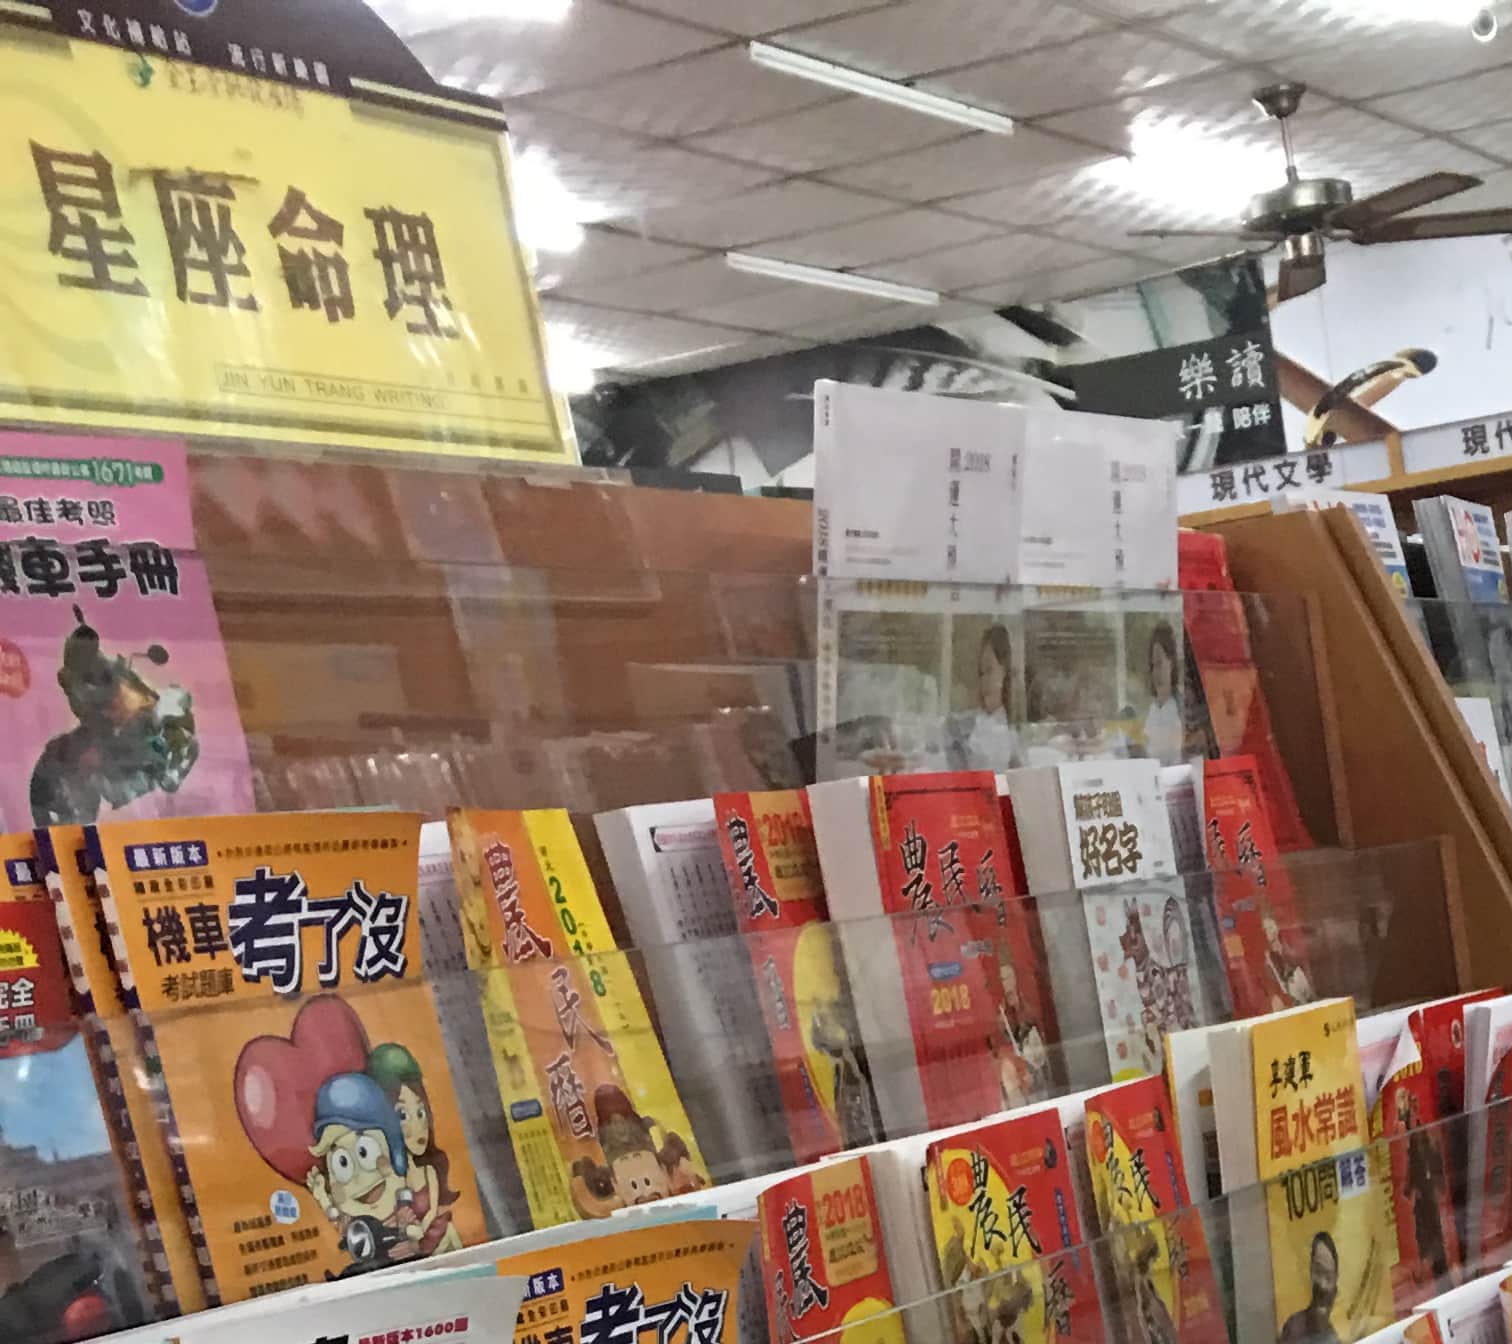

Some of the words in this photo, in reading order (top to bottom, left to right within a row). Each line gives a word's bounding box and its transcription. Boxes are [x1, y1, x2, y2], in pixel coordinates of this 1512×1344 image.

[29, 139, 462, 339] 星座命理
[259, 373, 297, 394] YUN
[1178, 341, 1265, 400] 樂讀
[1210, 452, 1333, 502] 現代文學
[133, 845, 204, 868] 最新版本
[1079, 822, 1143, 880] 好名字
[1269, 1086, 1360, 1161] 風水常識
